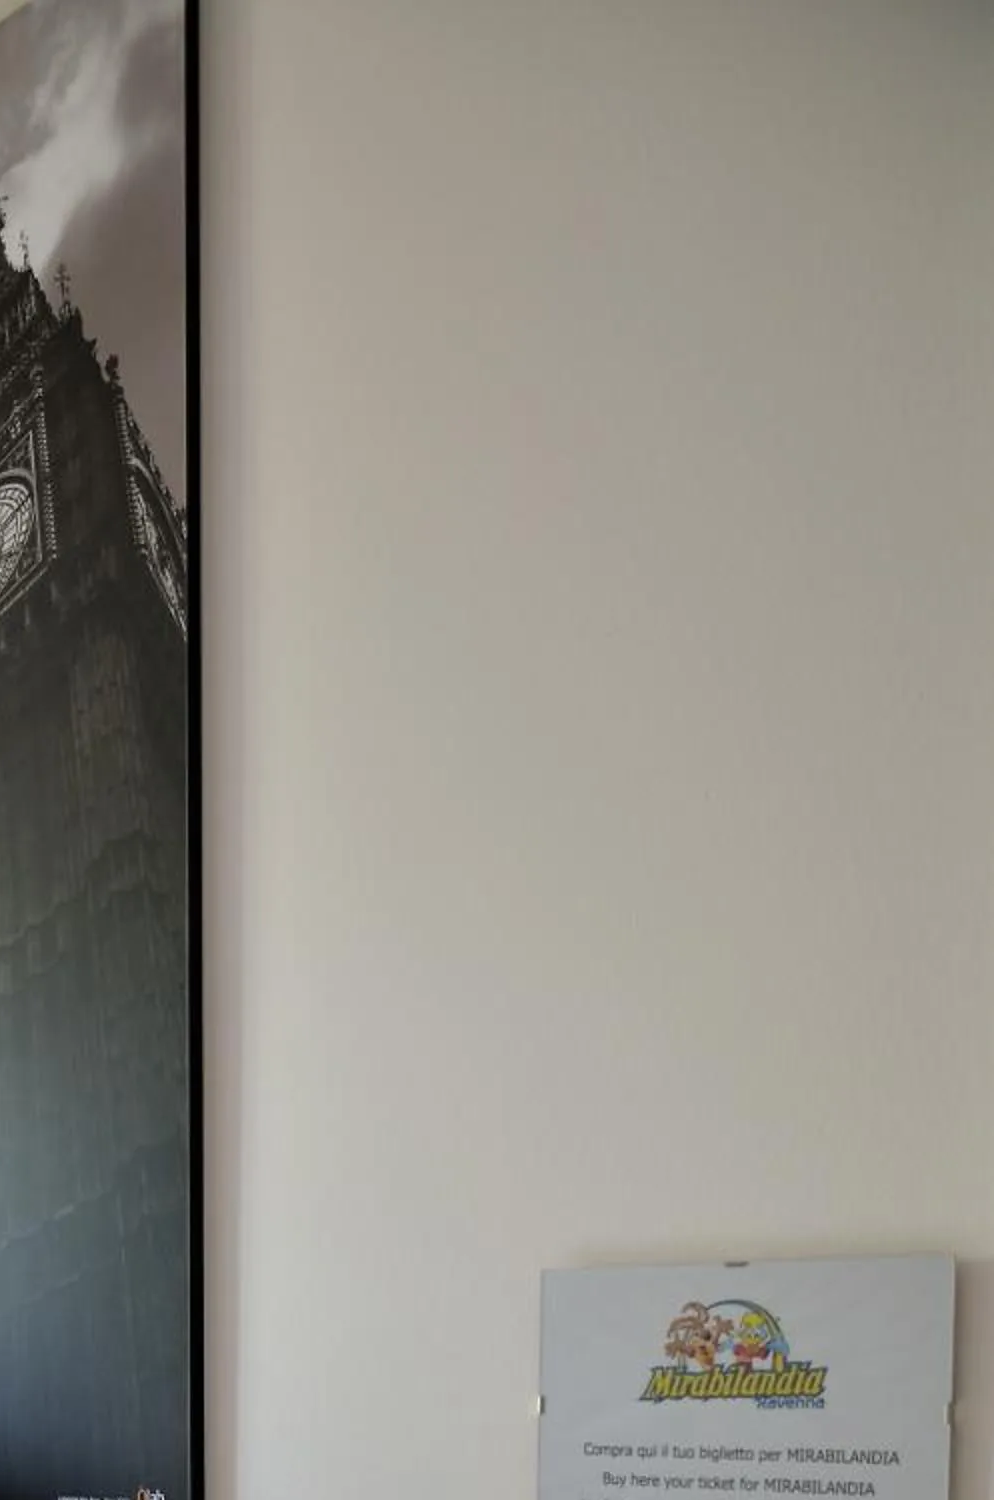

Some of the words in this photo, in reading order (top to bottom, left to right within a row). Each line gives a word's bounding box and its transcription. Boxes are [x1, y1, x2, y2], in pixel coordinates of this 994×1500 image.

[638, 1359, 828, 1403] Mirabilandia
[583, 1442, 633, 1459] Compra
[637, 1445, 657, 1461] qui
[661, 1444, 669, 1459] il
[673, 1446, 695, 1460] tuo
[699, 1445, 754, 1464] biglietto
[759, 1450, 781, 1464] per
[787, 1448, 899, 1466] MIRABILANDIA
[603, 1472, 625, 1489] Buy
[630, 1473, 659, 1488] here
[664, 1476, 694, 1491] your
[698, 1475, 734, 1491] ticket
[740, 1476, 759, 1491] for
[764, 1479, 874, 1497] MIRABILANDIA
